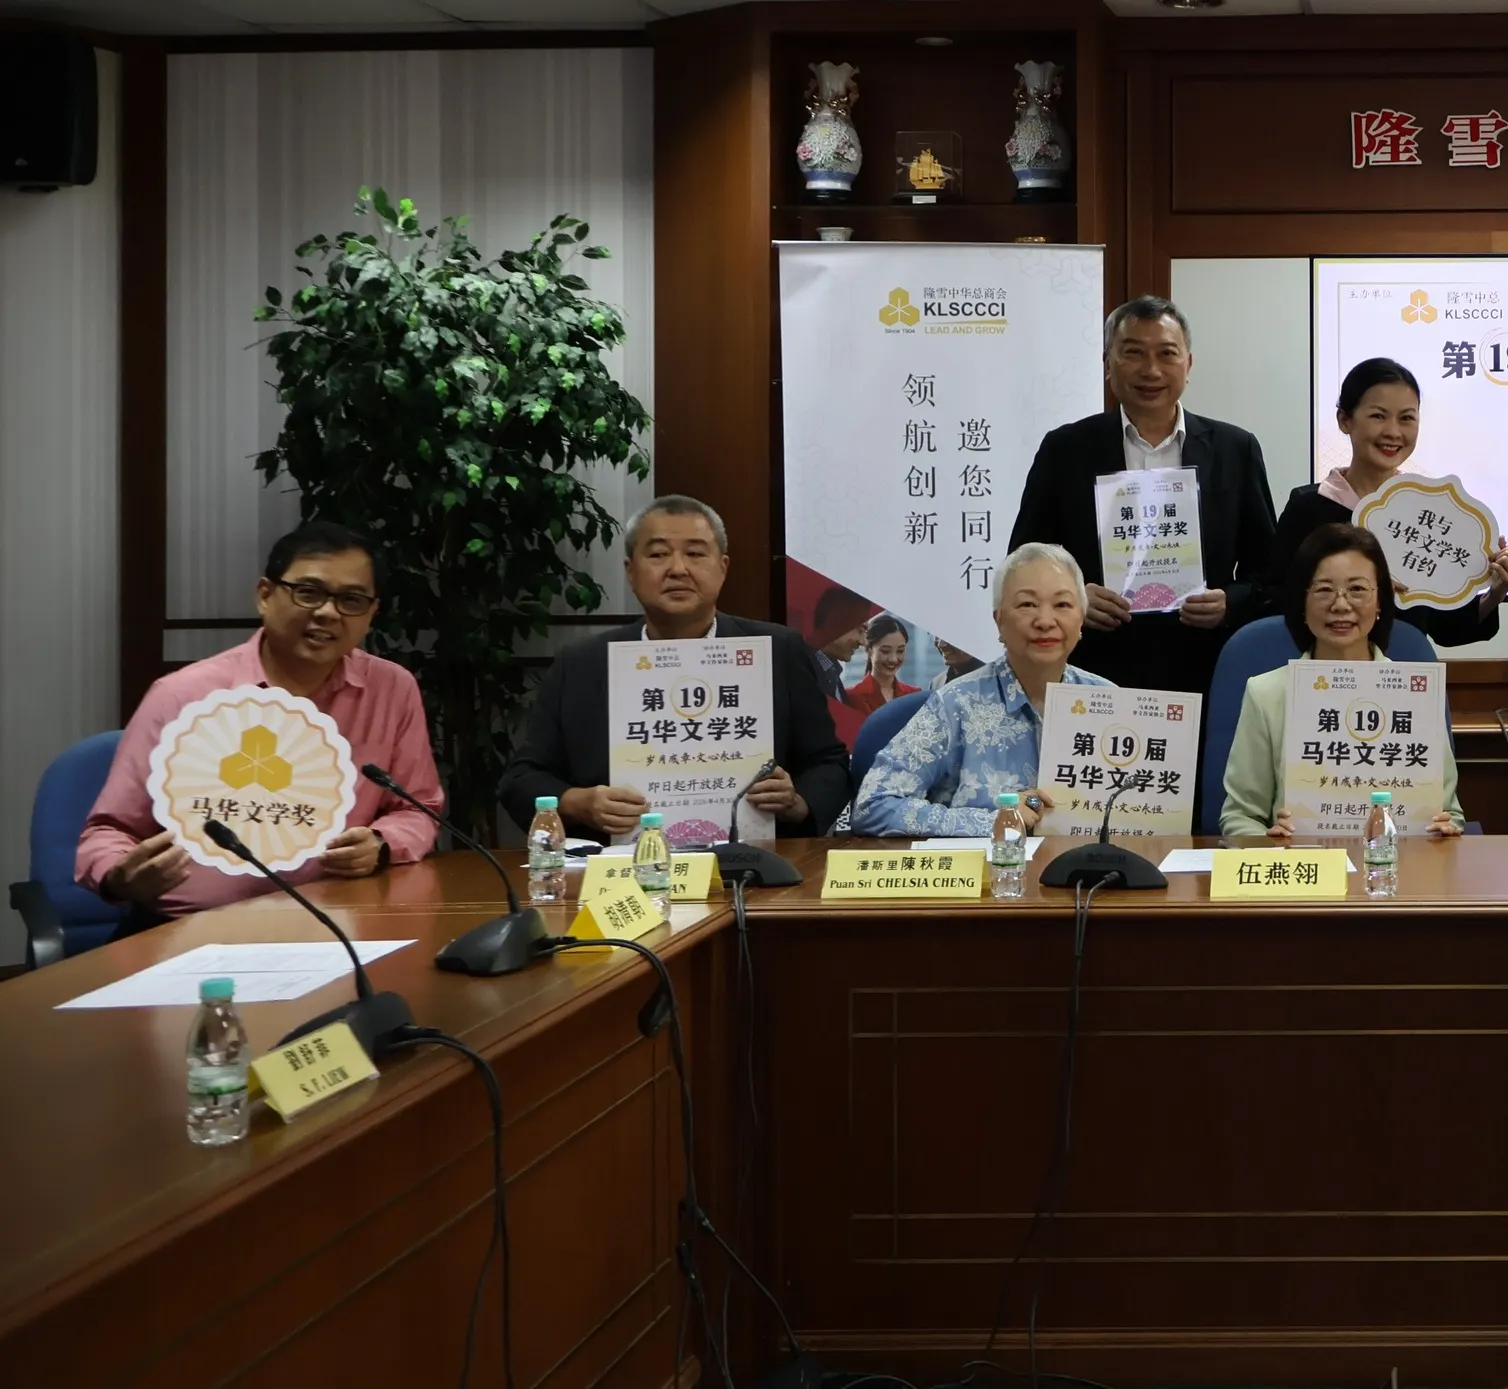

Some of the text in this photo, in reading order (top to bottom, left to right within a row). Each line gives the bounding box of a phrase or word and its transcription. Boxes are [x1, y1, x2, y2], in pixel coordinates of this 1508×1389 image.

[923, 287, 1007, 300] 隆雪中华总商会
[1447, 291, 1500, 304] 隆雪中总
[924, 302, 1005, 317] KLSCCCI
[1445, 309, 1503, 320] KLSCCCI
[924, 326, 1005, 335] LEAD AND GROW
[902, 373, 938, 546] 领航创新
[958, 418, 993, 591] 邀您同行
[1113, 521, 1188, 540] 马华文学奖
[1418, 509, 1453, 535] 我与
[1384, 518, 1471, 567] 马华文学奖
[1402, 551, 1437, 577] 有约
[626, 716, 758, 744] 马华文学奖
[1301, 741, 1429, 768] 马华文学奖
[648, 777, 737, 794] 即日起开放提名
[1054, 764, 1181, 795] 马华文学奖
[190, 796, 316, 827] 马华文学奖
[1320, 802, 1406, 816] 即日起开名
[830, 877, 975, 889] Puan Sri CHELSIA CHENG
[1236, 861, 1319, 886] 伍燕翎
